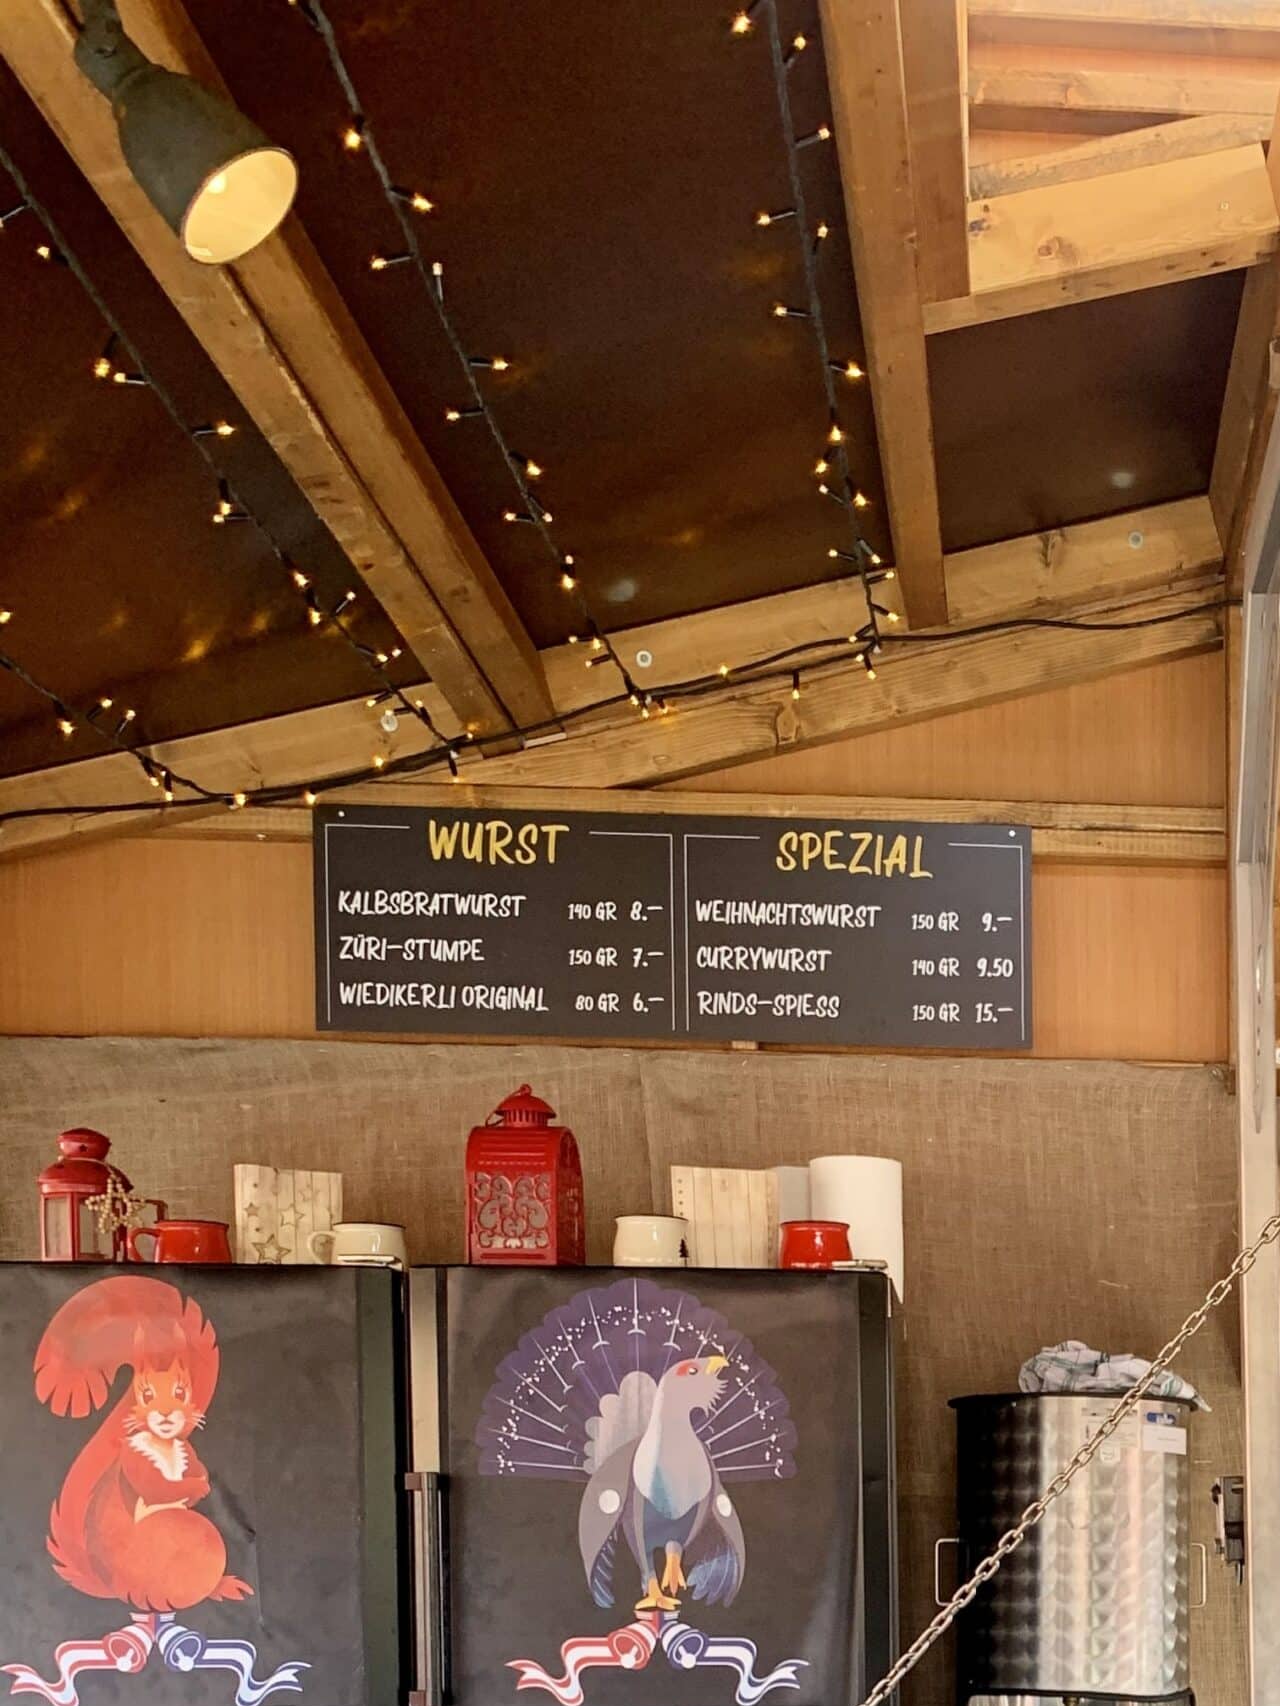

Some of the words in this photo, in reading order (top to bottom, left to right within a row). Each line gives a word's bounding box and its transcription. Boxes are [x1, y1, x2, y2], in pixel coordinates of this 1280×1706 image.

[428, 819, 570, 865] WURST
[776, 830, 933, 878] SPEZIAL
[338, 889, 527, 918] KALBSBRATWURST
[568, 903, 592, 920] 140
[595, 901, 618, 921] GR
[695, 899, 882, 929] WEIHNACHTSWURST
[911, 913, 934, 930] 150
[937, 911, 960, 932] GR
[339, 934, 485, 962] ZÜRI-STUMPE
[568, 949, 592, 966] 150
[595, 947, 618, 967] GR
[696, 945, 833, 972] CURRYWURST
[911, 959, 935, 976] 140
[938, 957, 960, 977] GR
[976, 957, 1014, 978] 9.50
[339, 981, 456, 1009] WIEDIKERLI
[461, 984, 549, 1012] ORIGINAL
[575, 994, 594, 1011] 80
[597, 993, 620, 1013] GR
[696, 990, 840, 1018] RINDS-SPIESS
[912, 1004, 935, 1021] 150
[938, 1002, 961, 1023] GR
